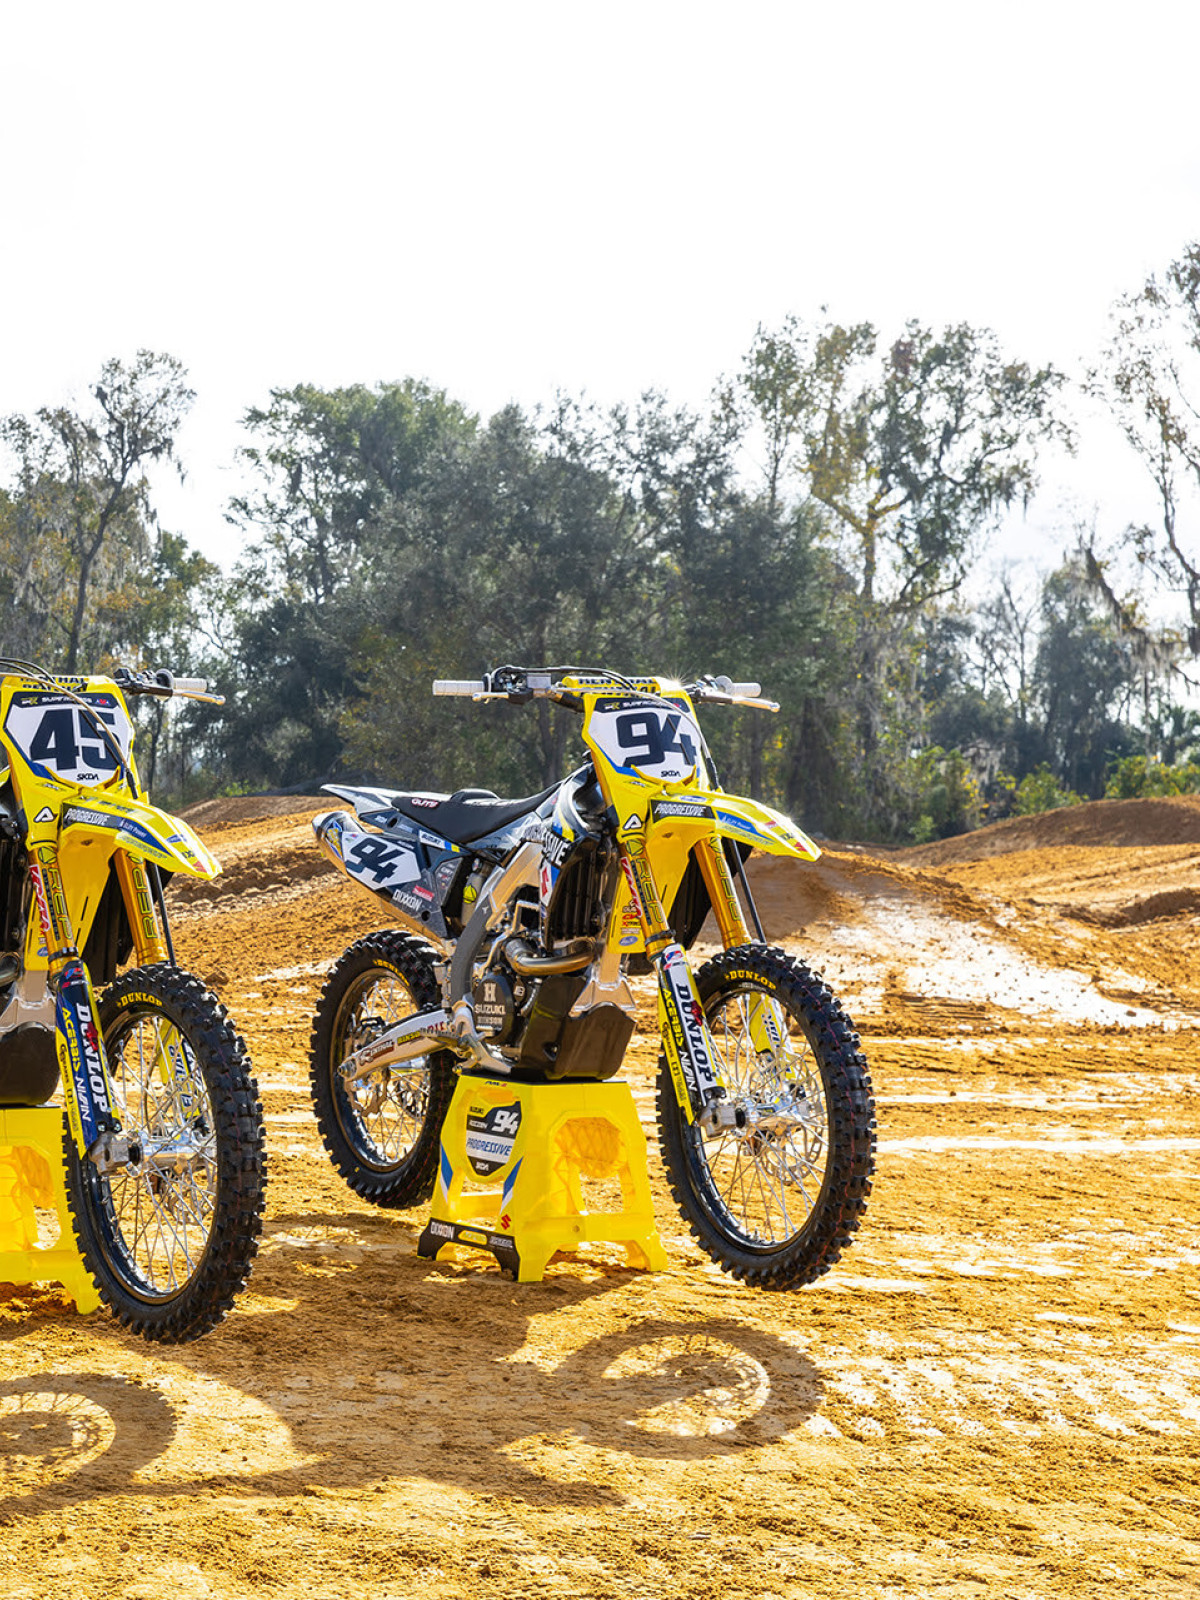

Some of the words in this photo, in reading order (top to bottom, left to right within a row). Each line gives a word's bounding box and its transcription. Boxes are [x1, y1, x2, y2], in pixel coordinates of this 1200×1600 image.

[28, 708, 122, 772] 45
[615, 711, 697, 768] 94
[76, 773, 99, 781] SKDA
[653, 802, 707, 817] PROGRESSIVE
[344, 837, 406, 884] 94
[47, 867, 73, 940] REP
[392, 888, 423, 912] DIXXON
[635, 857, 664, 924] REP
[120, 991, 163, 1008] DUNLOP
[728, 969, 777, 990] DUNLOP
[474, 1004, 507, 1015] SUZUKI
[662, 987, 685, 1048] ACERBIS
[675, 983, 713, 1082] DUNLOP
[61, 1006, 82, 1073] ACERBIS
[491, 1109, 520, 1135] 94
